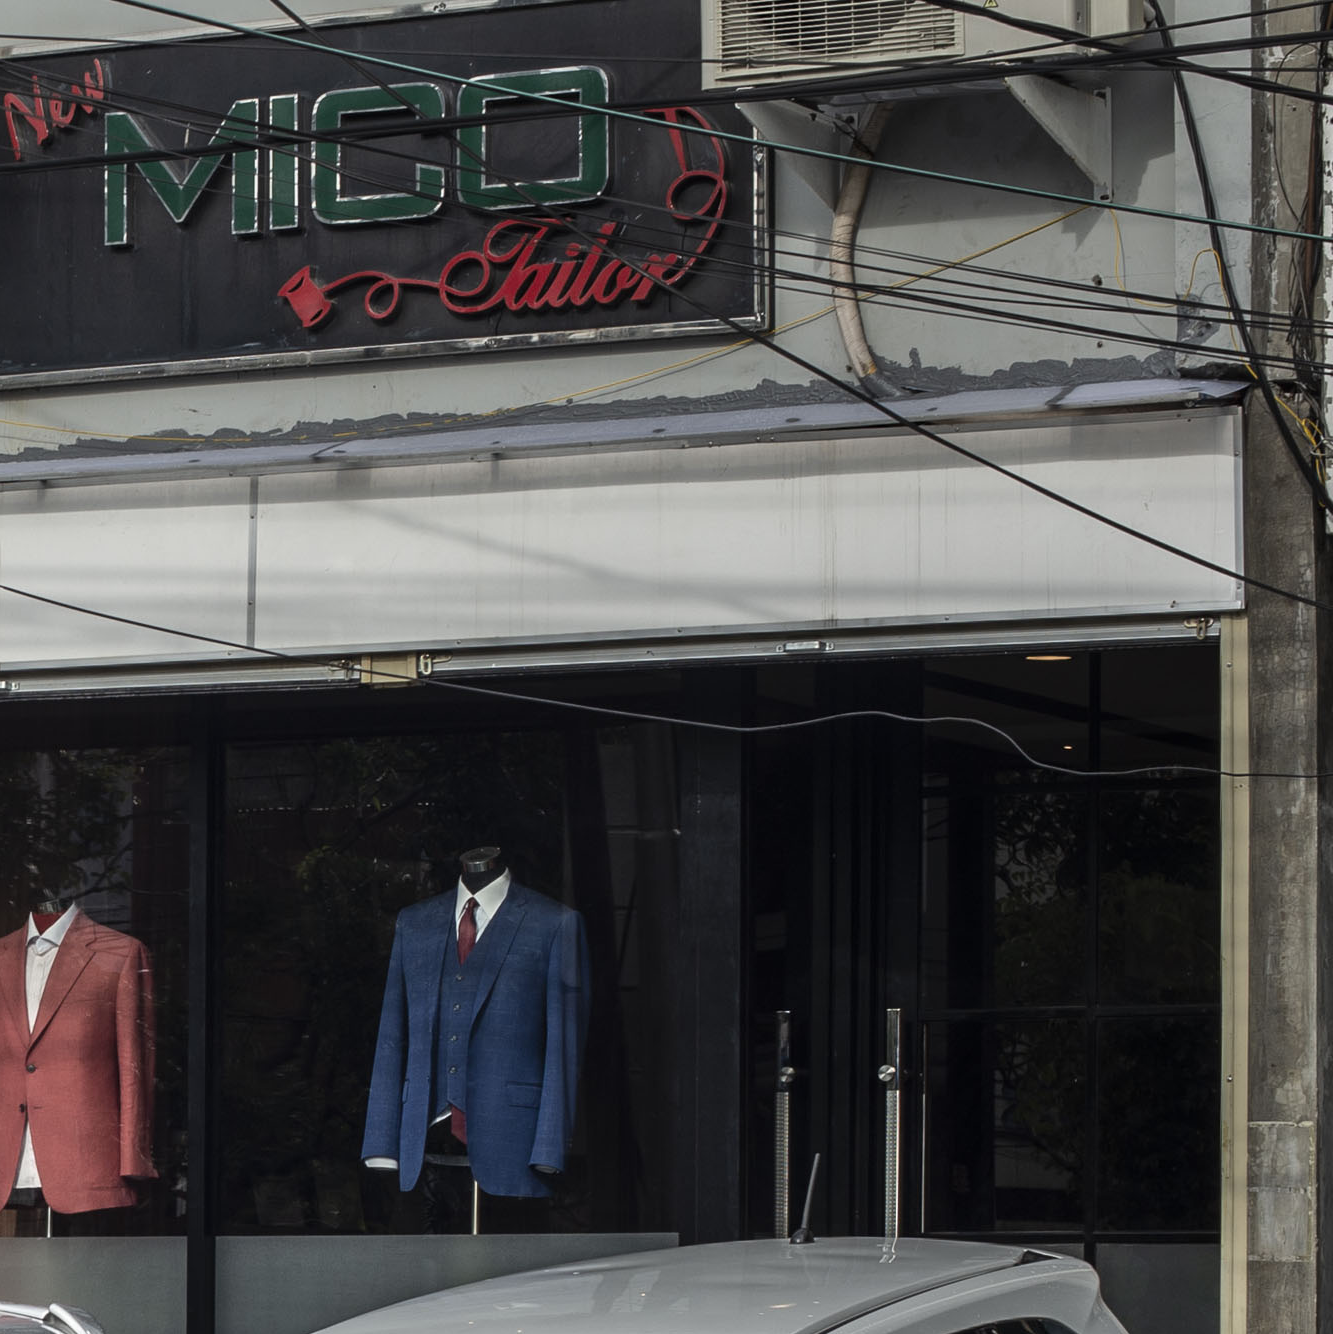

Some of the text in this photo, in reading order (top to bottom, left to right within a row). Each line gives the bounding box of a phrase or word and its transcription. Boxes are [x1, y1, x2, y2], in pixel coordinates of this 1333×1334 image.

[3, 57, 106, 161] New
[103, 64, 612, 248] MICO
[458, 215, 681, 313] Tailor
